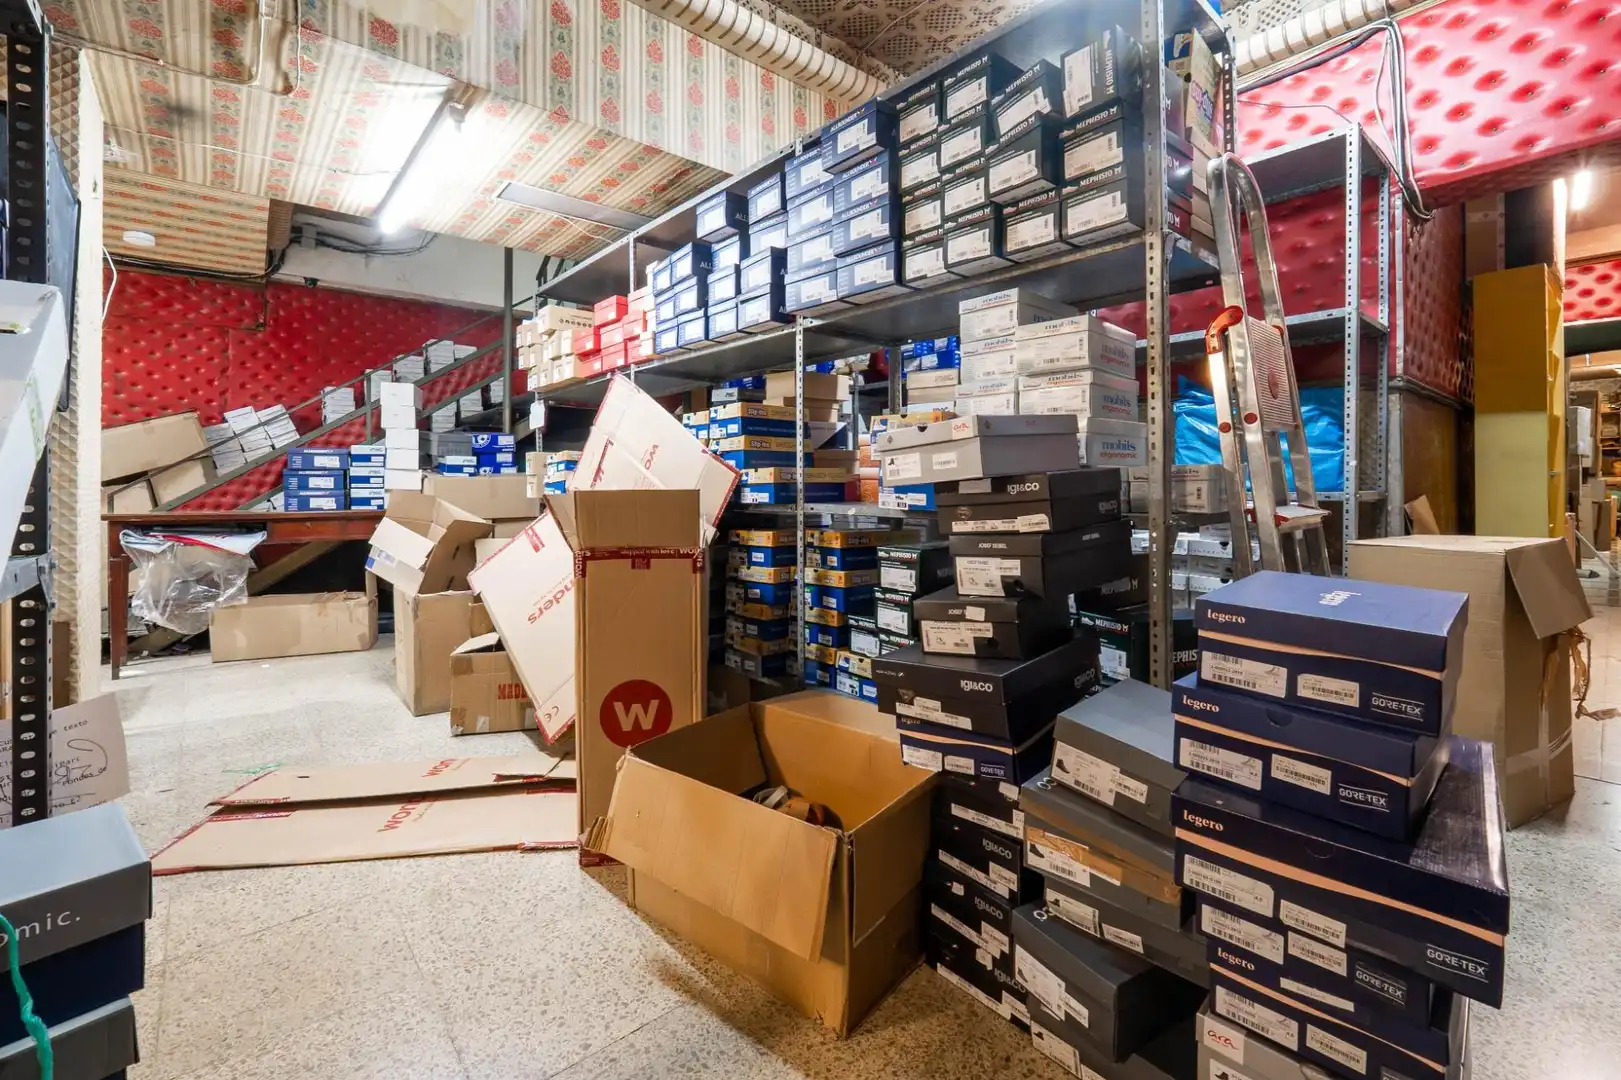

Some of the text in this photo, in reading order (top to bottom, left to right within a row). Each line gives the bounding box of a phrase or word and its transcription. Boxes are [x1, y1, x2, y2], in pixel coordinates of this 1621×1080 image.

[1076, 109, 1109, 129] MEPHISTO
[1080, 169, 1113, 186] MEPHISTO
[1101, 403, 1132, 416] ergonomic
[1103, 392, 1131, 408] mobils
[1102, 439, 1137, 451] mobils
[1100, 452, 1137, 460] ergonomic
[1095, 618, 1121, 631] MEPHISTO
[1207, 608, 1246, 626] legero
[1182, 694, 1220, 714] legero
[1371, 695, 1423, 717] GORE-TEX
[1338, 786, 1388, 807] GORE-TEX
[1183, 808, 1224, 833] legero
[1217, 946, 1256, 973] legero
[1427, 947, 1487, 977] GORE-TEX
[1355, 969, 1404, 999] GORE-TEX
[1207, 1028, 1241, 1052] ara
